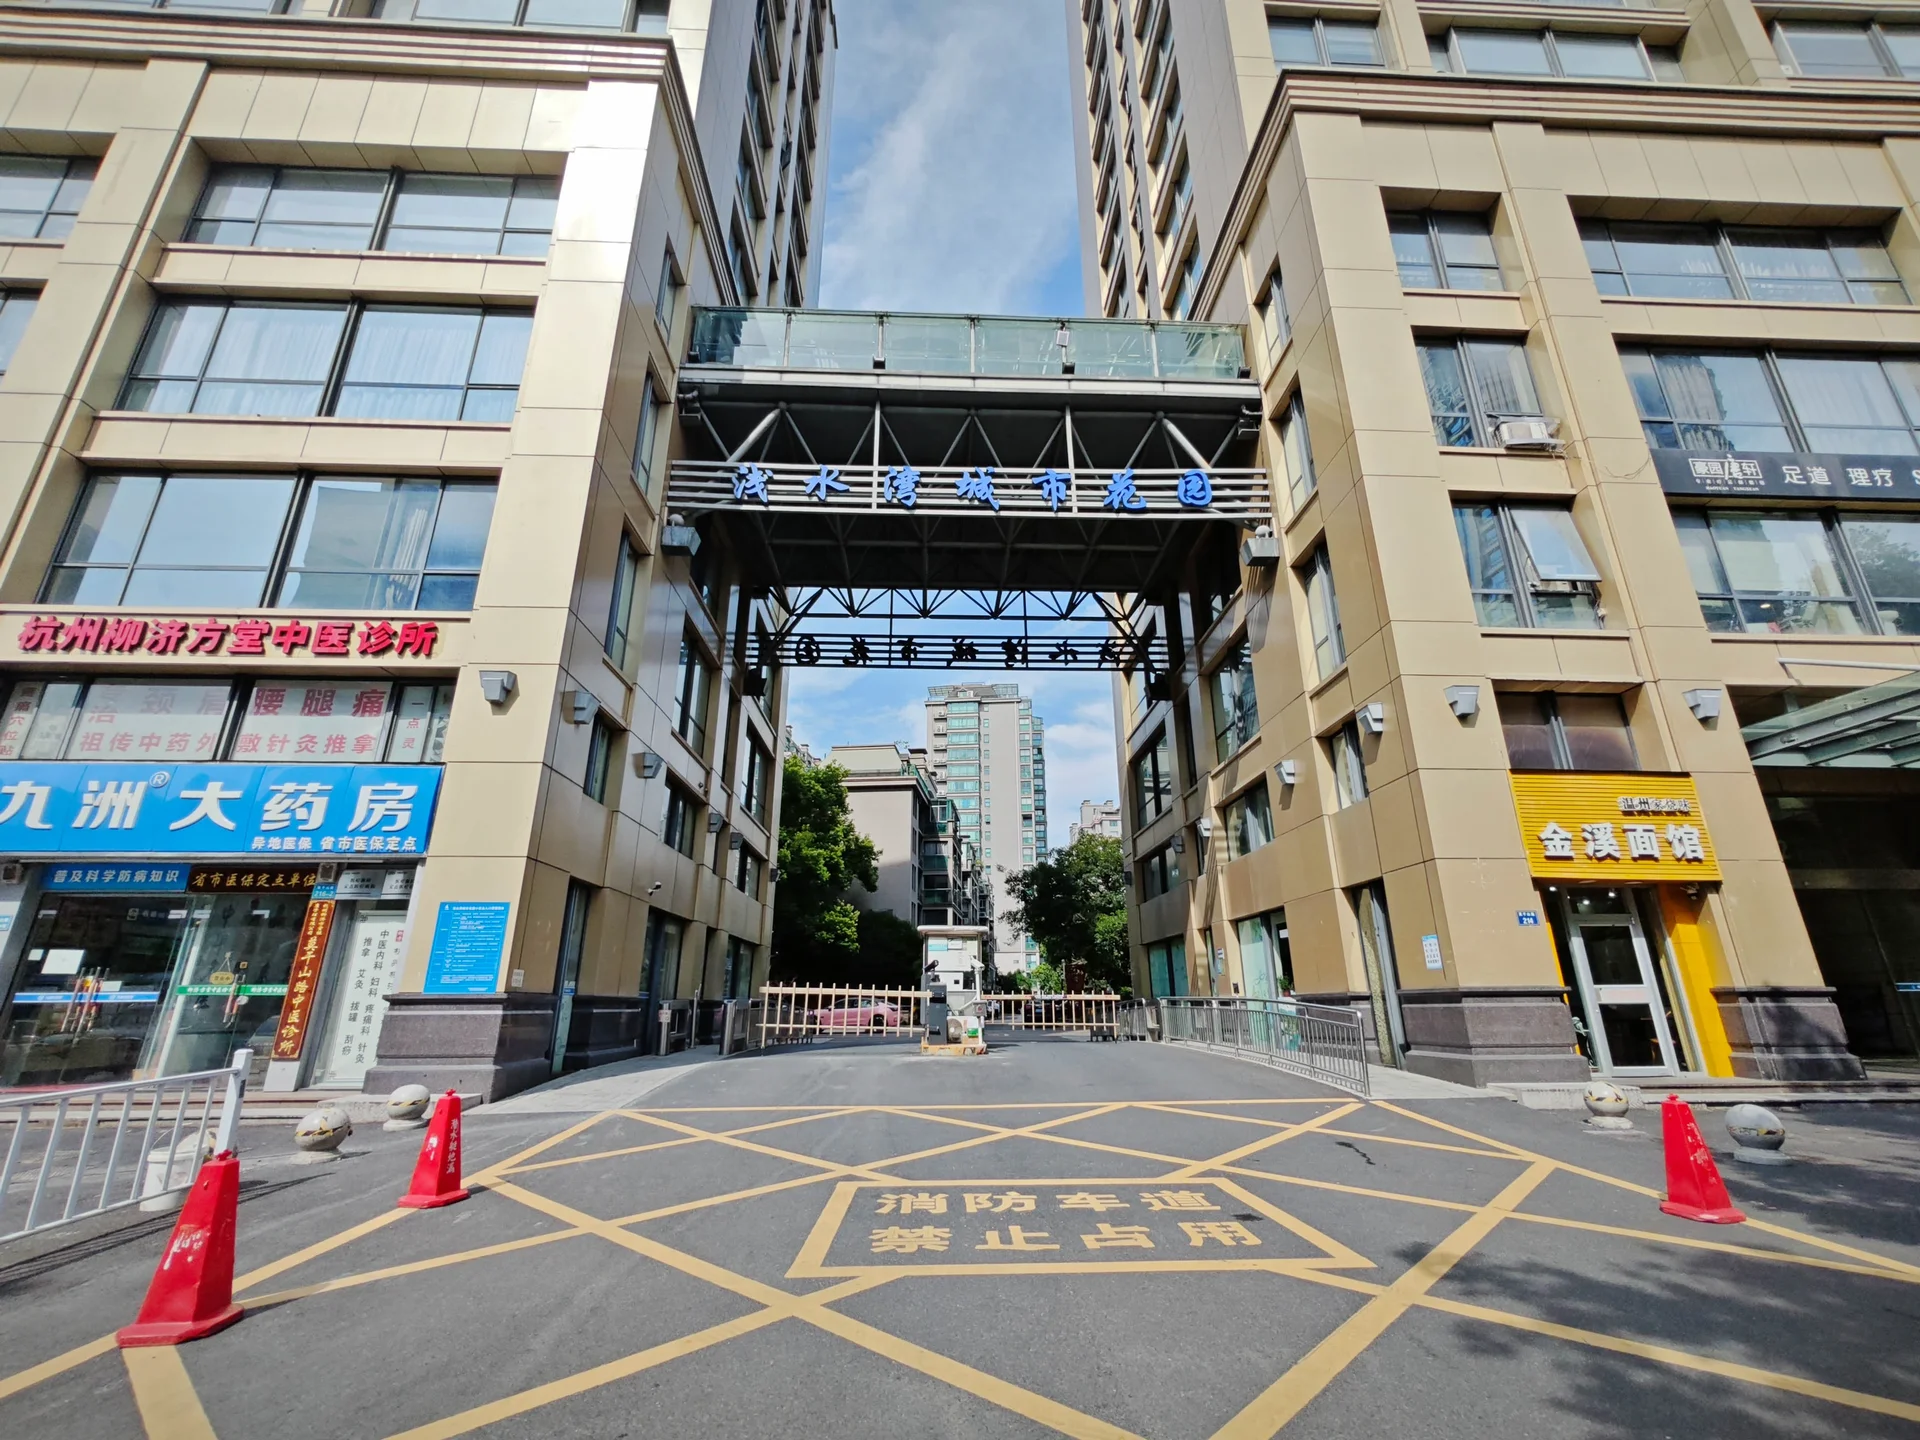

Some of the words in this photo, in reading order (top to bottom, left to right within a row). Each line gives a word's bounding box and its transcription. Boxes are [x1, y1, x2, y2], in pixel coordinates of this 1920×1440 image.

[732, 463, 1212, 512] 浅水湾城市花园
[1782, 466, 1831, 486] 足道
[1847, 468, 1894, 487] 理疗
[17, 615, 440, 656] 杭州柳济方堂中医诊所
[251, 836, 312, 851] 异地医保
[320, 837, 417, 852] 省市医保定点
[1538, 822, 1704, 862] 金溪面馆
[53, 868, 180, 884] 普及科学防病知识
[192, 871, 316, 888] 省市医保定点单位
[361, 937, 373, 957] 推拿
[373, 930, 390, 971] 中医内科
[368, 977, 380, 998] 妇科
[876, 1190, 1222, 1214] 消防车道
[869, 1220, 1264, 1254] 禁止占用
